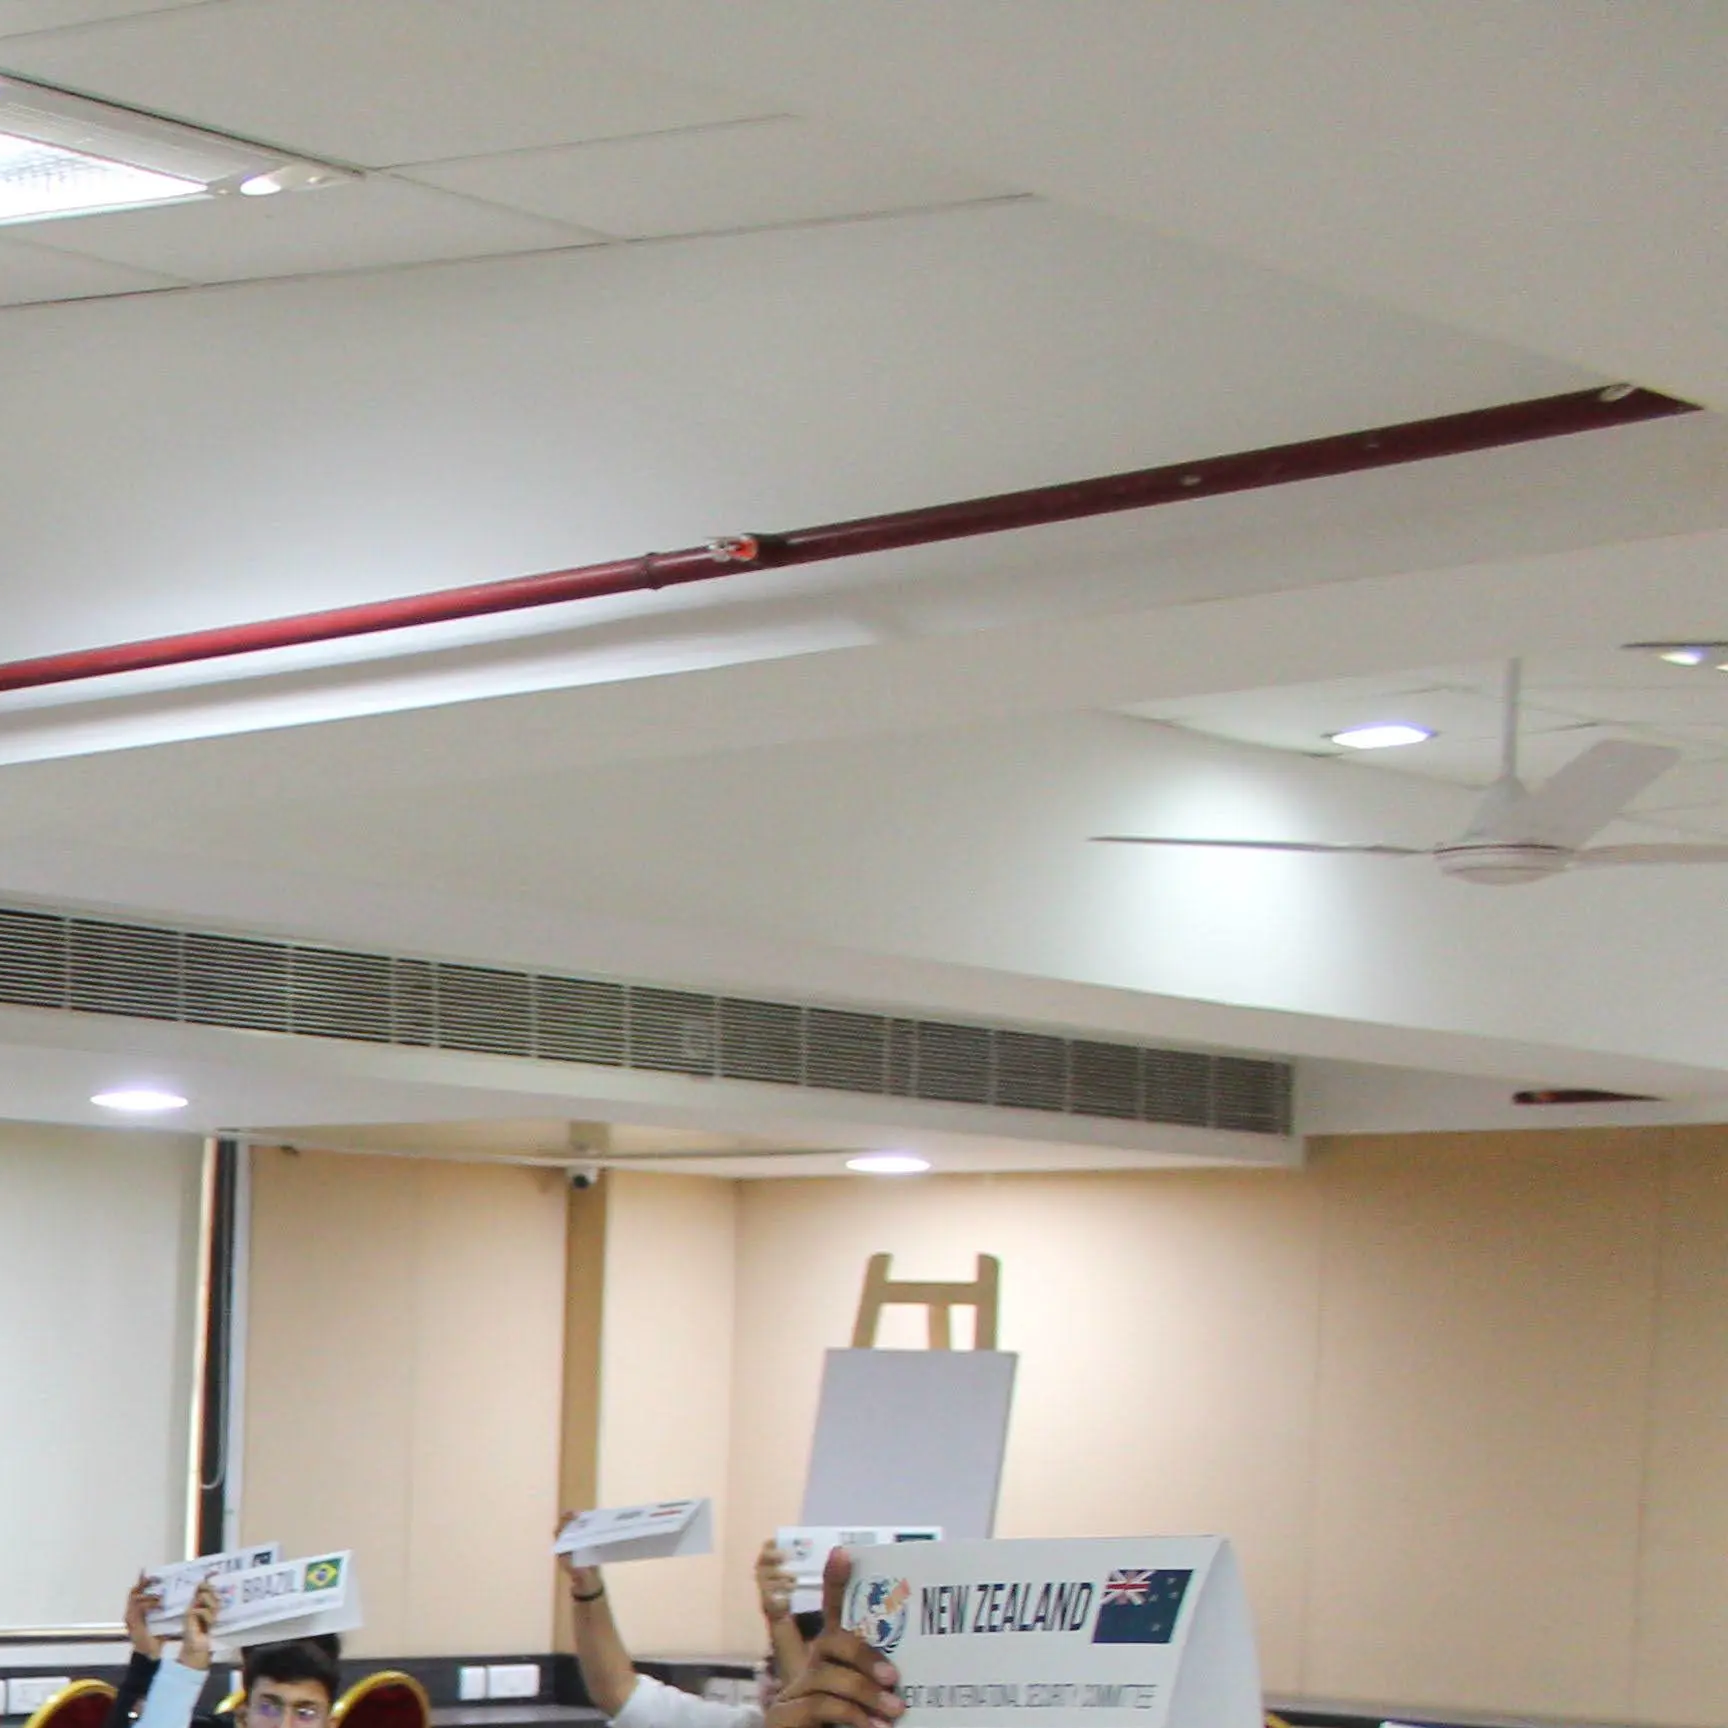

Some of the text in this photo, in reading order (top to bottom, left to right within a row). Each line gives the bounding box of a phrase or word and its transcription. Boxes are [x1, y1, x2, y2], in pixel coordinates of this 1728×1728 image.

[241, 1568, 299, 1604] BRAZIL
[920, 1581, 1094, 1636] NEW ZEALAND
